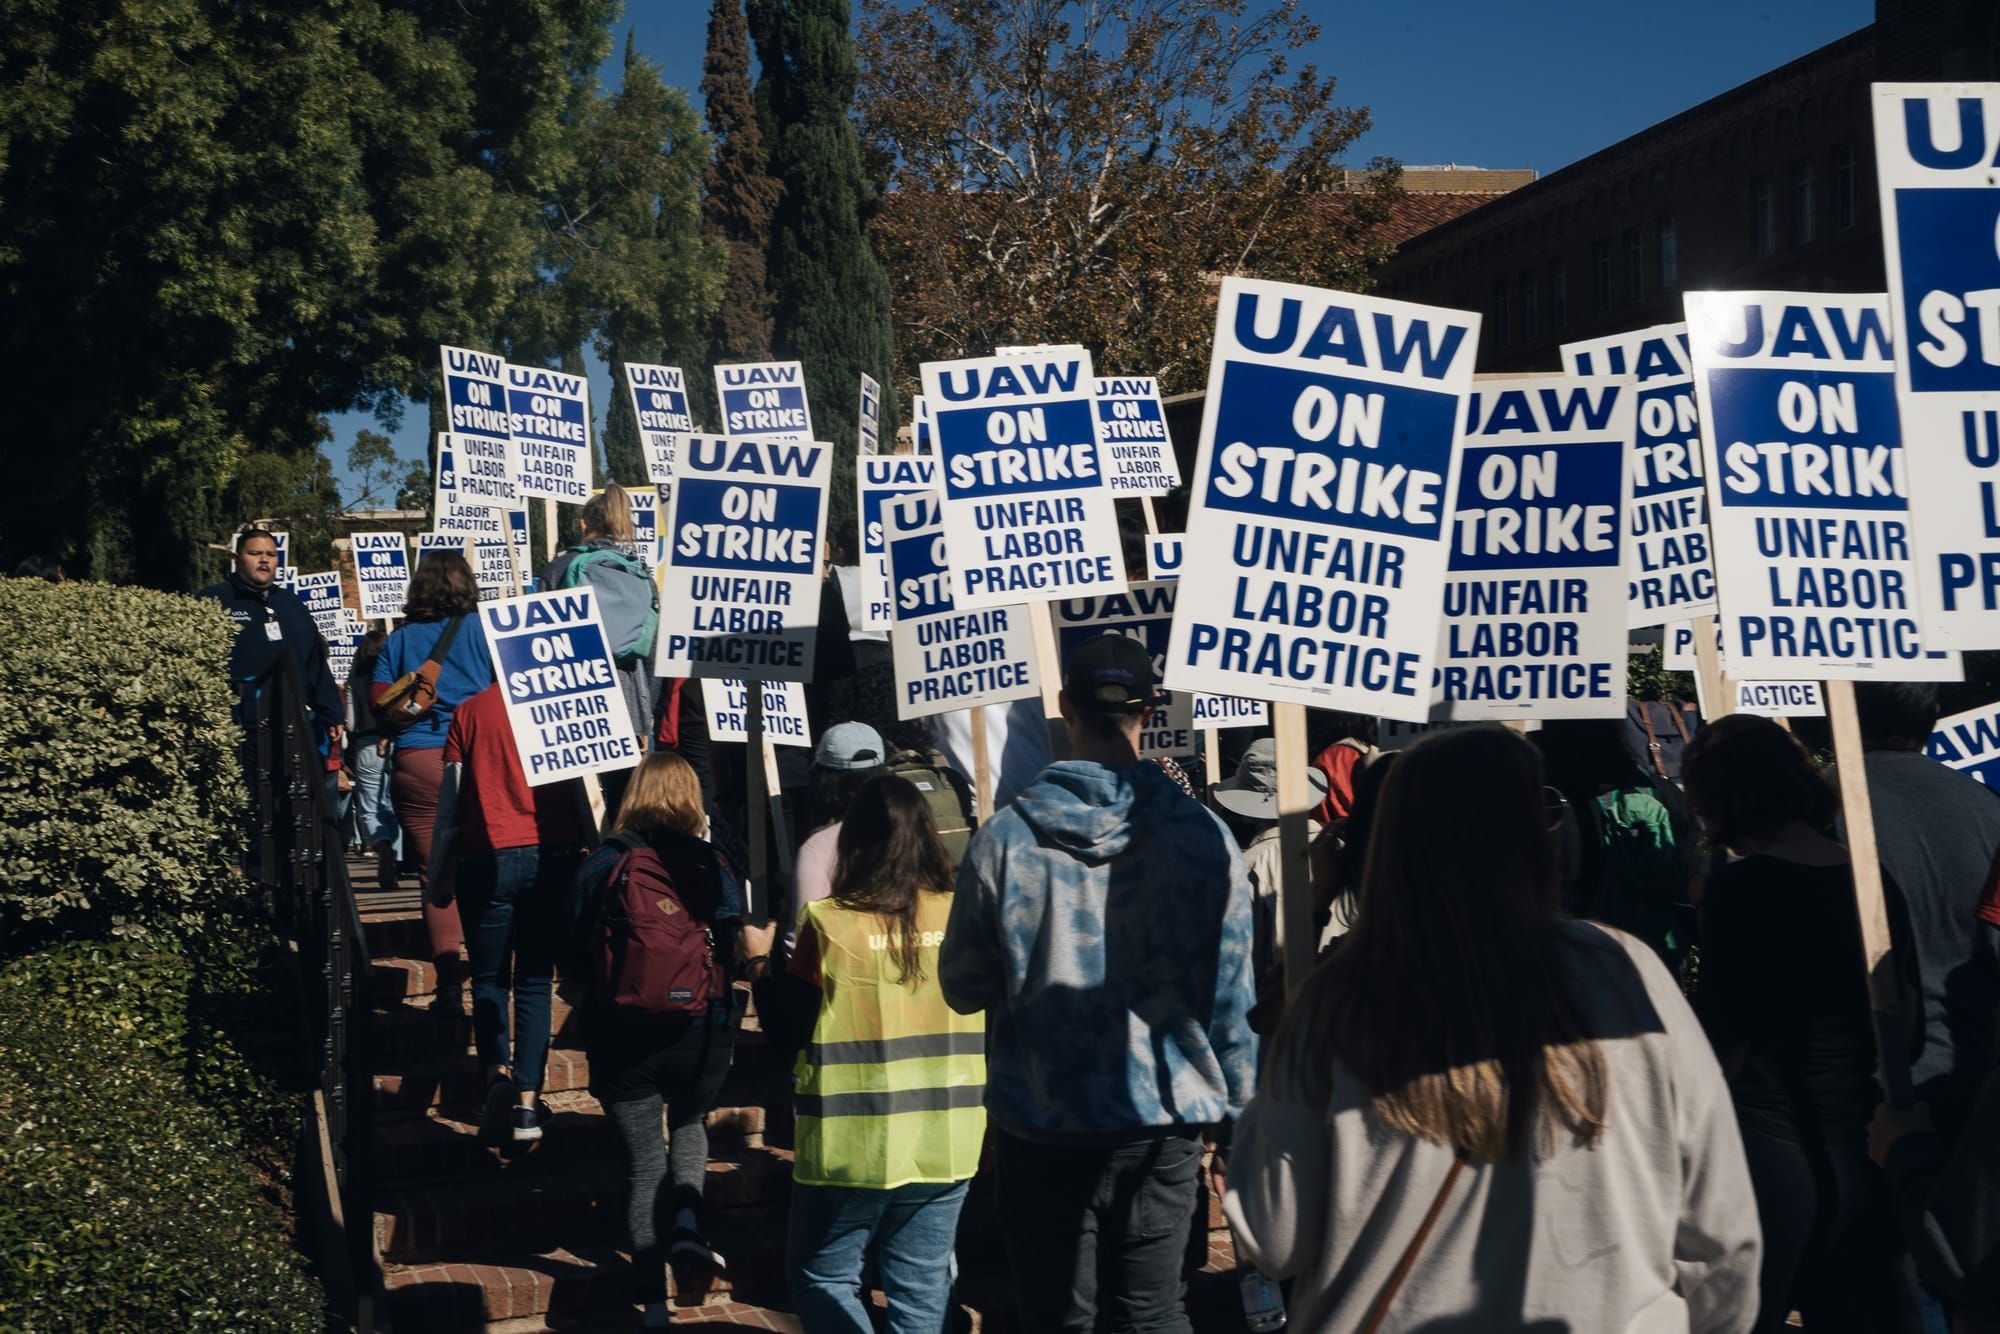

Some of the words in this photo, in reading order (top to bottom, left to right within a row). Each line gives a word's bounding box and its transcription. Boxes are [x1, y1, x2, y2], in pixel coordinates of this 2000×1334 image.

[1233, 292, 1469, 381] UAW
[448, 350, 501, 379] UAW
[629, 367, 680, 389] UAW
[723, 366, 797, 386] UAW
[467, 382, 492, 406] ON
[509, 369, 581, 396] UAW
[938, 360, 1080, 402] UAW
[530, 396, 562, 418] ON
[651, 392, 672, 411] ON
[748, 389, 780, 409] ON
[1112, 401, 1141, 419] ON
[1777, 381, 1859, 435] ON
[453, 404, 510, 434] STRIKE
[510, 413, 585, 442] STRIKE
[640, 411, 690, 431] STRIKE
[729, 408, 807, 431] STRIKE
[986, 407, 1047, 445] ON
[1101, 420, 1164, 439] STRIKE
[1292, 384, 1385, 449] ON
[464, 439, 505, 460] UNFAIR
[520, 442, 576, 463] UNFAIR
[688, 438, 822, 478] UAW
[1112, 446, 1161, 459] UNFAIR
[469, 458, 506, 479] LABOR
[524, 459, 574, 479] LABOR
[950, 443, 1098, 489] STRIKE
[1117, 461, 1162, 474] LABOR
[1478, 450, 1558, 501] ON
[461, 477, 516, 499] PRACTICE
[1110, 475, 1176, 490] PRACTICE
[1213, 441, 1443, 525] STRIKE
[450, 506, 490, 518] LABOR
[721, 486, 778, 523] ON
[974, 497, 1086, 531] UNFAIR
[440, 518, 499, 532] PRACTICE
[1754, 516, 1910, 562] UNFAIR
[355, 535, 401, 549] UAW
[421, 535, 464, 547] UAW
[480, 547, 521, 559] UNFAR
[676, 522, 814, 564] STRIKE
[984, 528, 1085, 562] LABOR
[371, 552, 392, 566] ON
[482, 560, 519, 571] LABO
[1232, 522, 1407, 590] UNFAIR
[297, 574, 337, 588] UAW
[360, 566, 407, 580] STRIKE
[368, 582, 403, 593] UNFAIR
[964, 555, 1115, 595] PRACTICE
[309, 587, 328, 600] ON
[372, 593, 404, 604] LABOR
[690, 575, 792, 606] UNFAIR
[1443, 578, 1588, 617] UNFAIR
[1768, 566, 1908, 610] LABOR
[303, 597, 341, 611] TRIKE
[488, 593, 590, 632] UAW
[1232, 575, 1391, 640] LABOR
[693, 606, 783, 635] LABOR
[917, 608, 1009, 647] UNFAIR
[530, 632, 575, 663] ON
[668, 634, 804, 668] PRACTICE
[1448, 621, 1579, 659] LABOR
[1738, 616, 1948, 660] PRACTIC
[924, 637, 1006, 674] LABOR
[1185, 623, 1421, 697] PRACTICE
[509, 657, 612, 698] STRIKE
[907, 661, 1031, 705] PRACTICE
[530, 694, 609, 726] UNFAIR
[727, 691, 787, 713] LAOR
[540, 716, 611, 748] LABOR
[715, 712, 804, 736] PRTICE
[530, 737, 634, 775] PRACTICE
